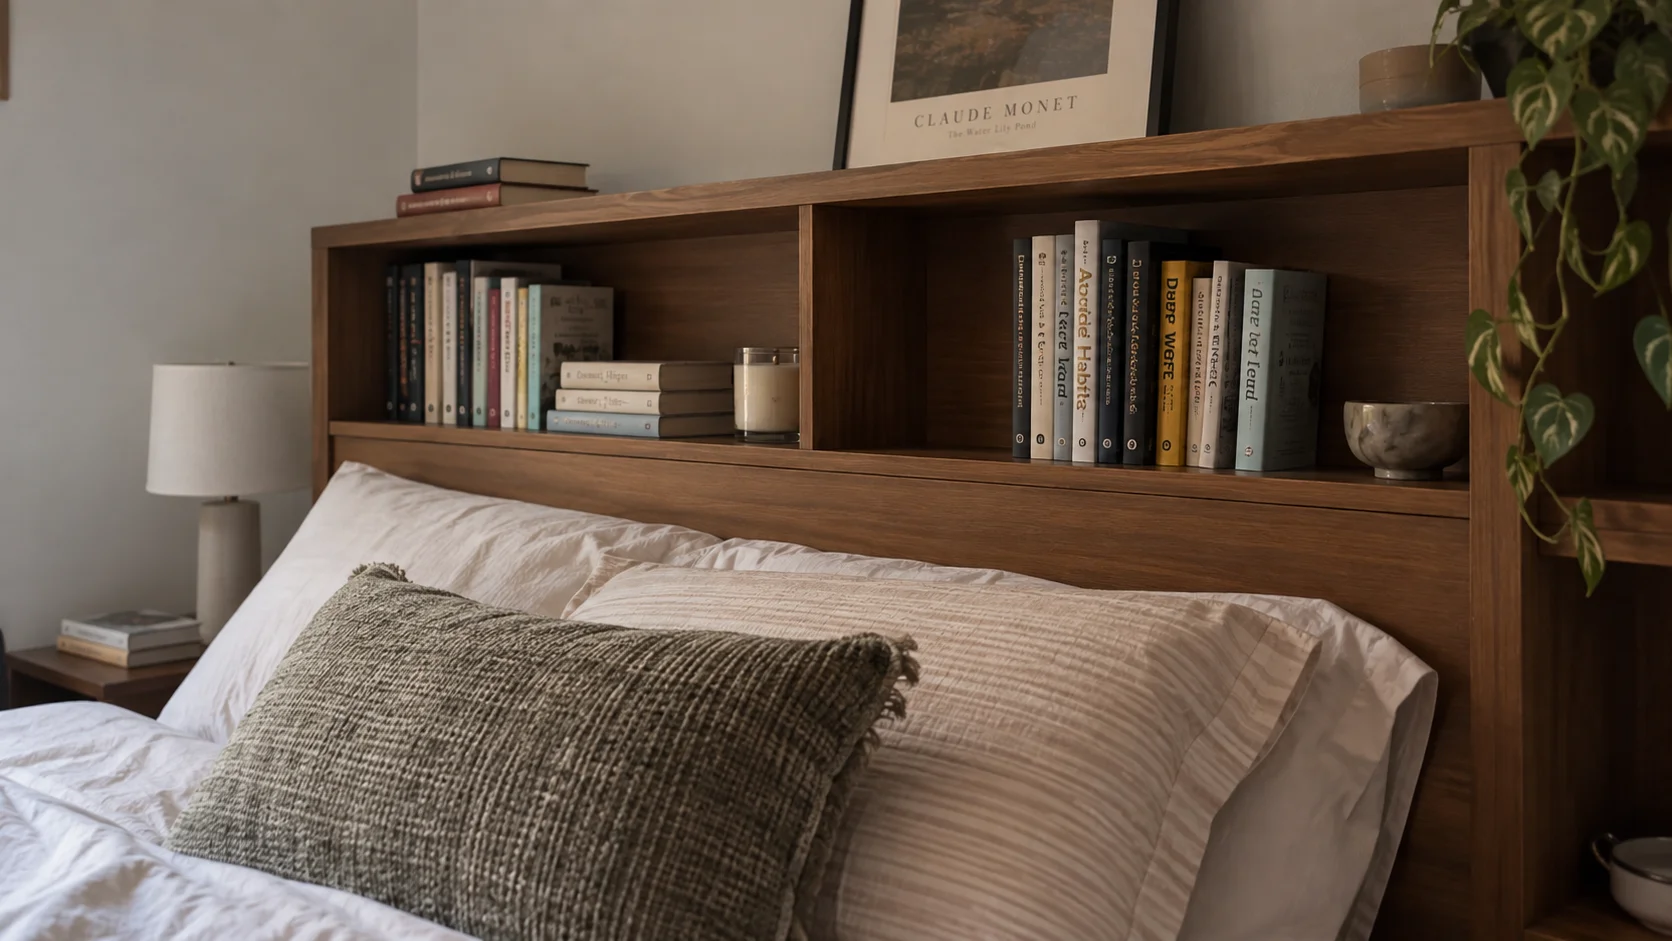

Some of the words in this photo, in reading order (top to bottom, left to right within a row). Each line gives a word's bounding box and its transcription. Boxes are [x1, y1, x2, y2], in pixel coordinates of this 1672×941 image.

[914, 106, 992, 128] CLAUDE
[1004, 95, 1078, 117] MONET
[948, 130, 963, 139] The
[966, 127, 991, 136] Water
[994, 123, 1011, 133] Lily
[1015, 121, 1037, 131] Pond
